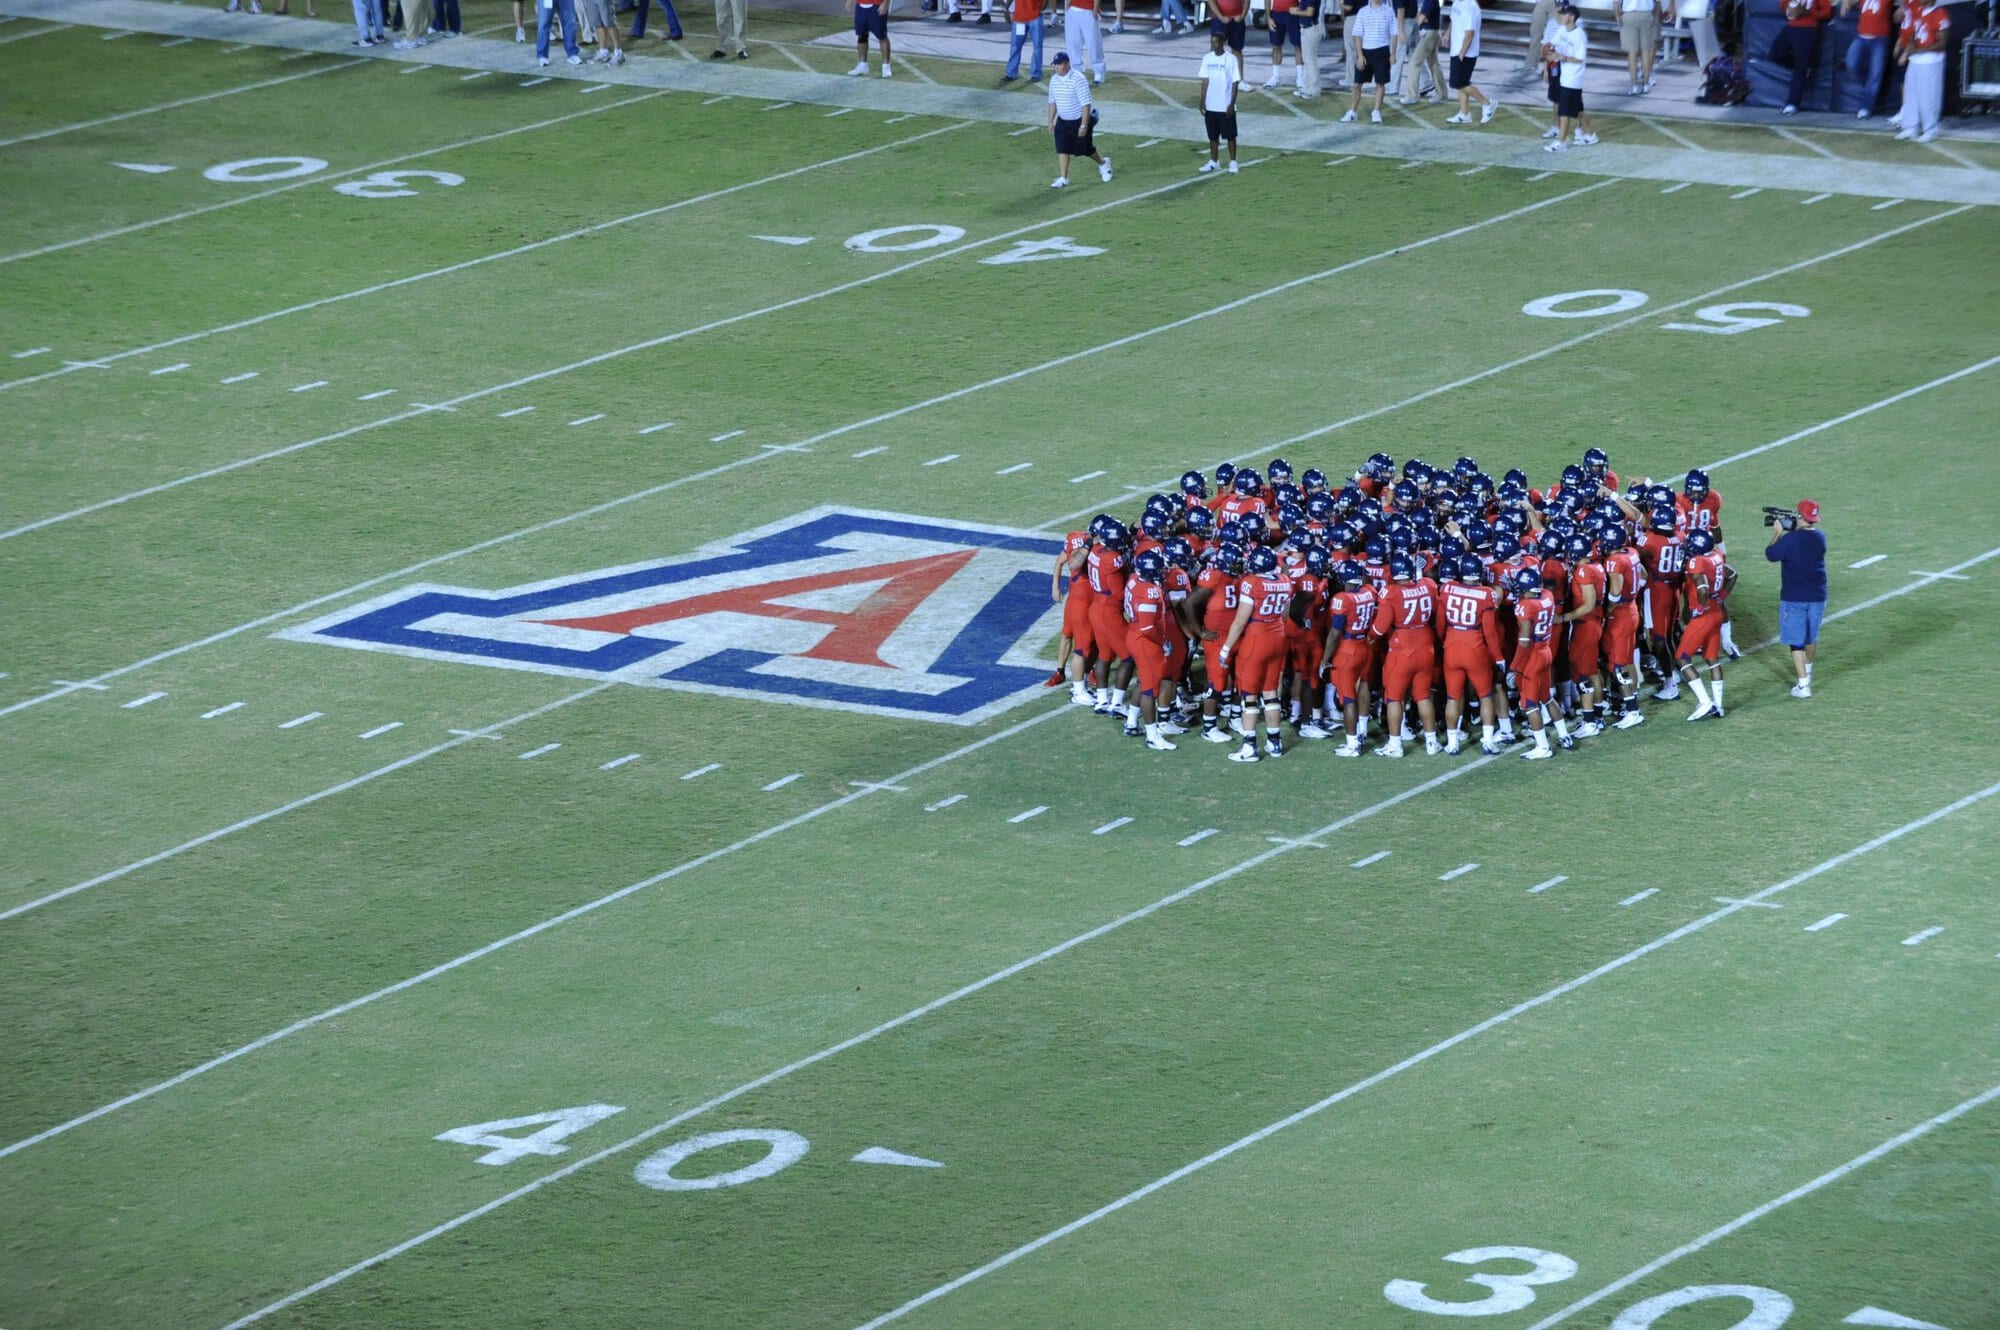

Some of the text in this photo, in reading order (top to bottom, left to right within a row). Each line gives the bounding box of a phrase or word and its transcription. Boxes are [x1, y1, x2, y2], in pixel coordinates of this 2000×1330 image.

[1606, 560, 1616, 572] 17
[1403, 596, 1432, 625] 79
[1446, 595, 1478, 625] 58
[432, 1103, 811, 1192] 40
